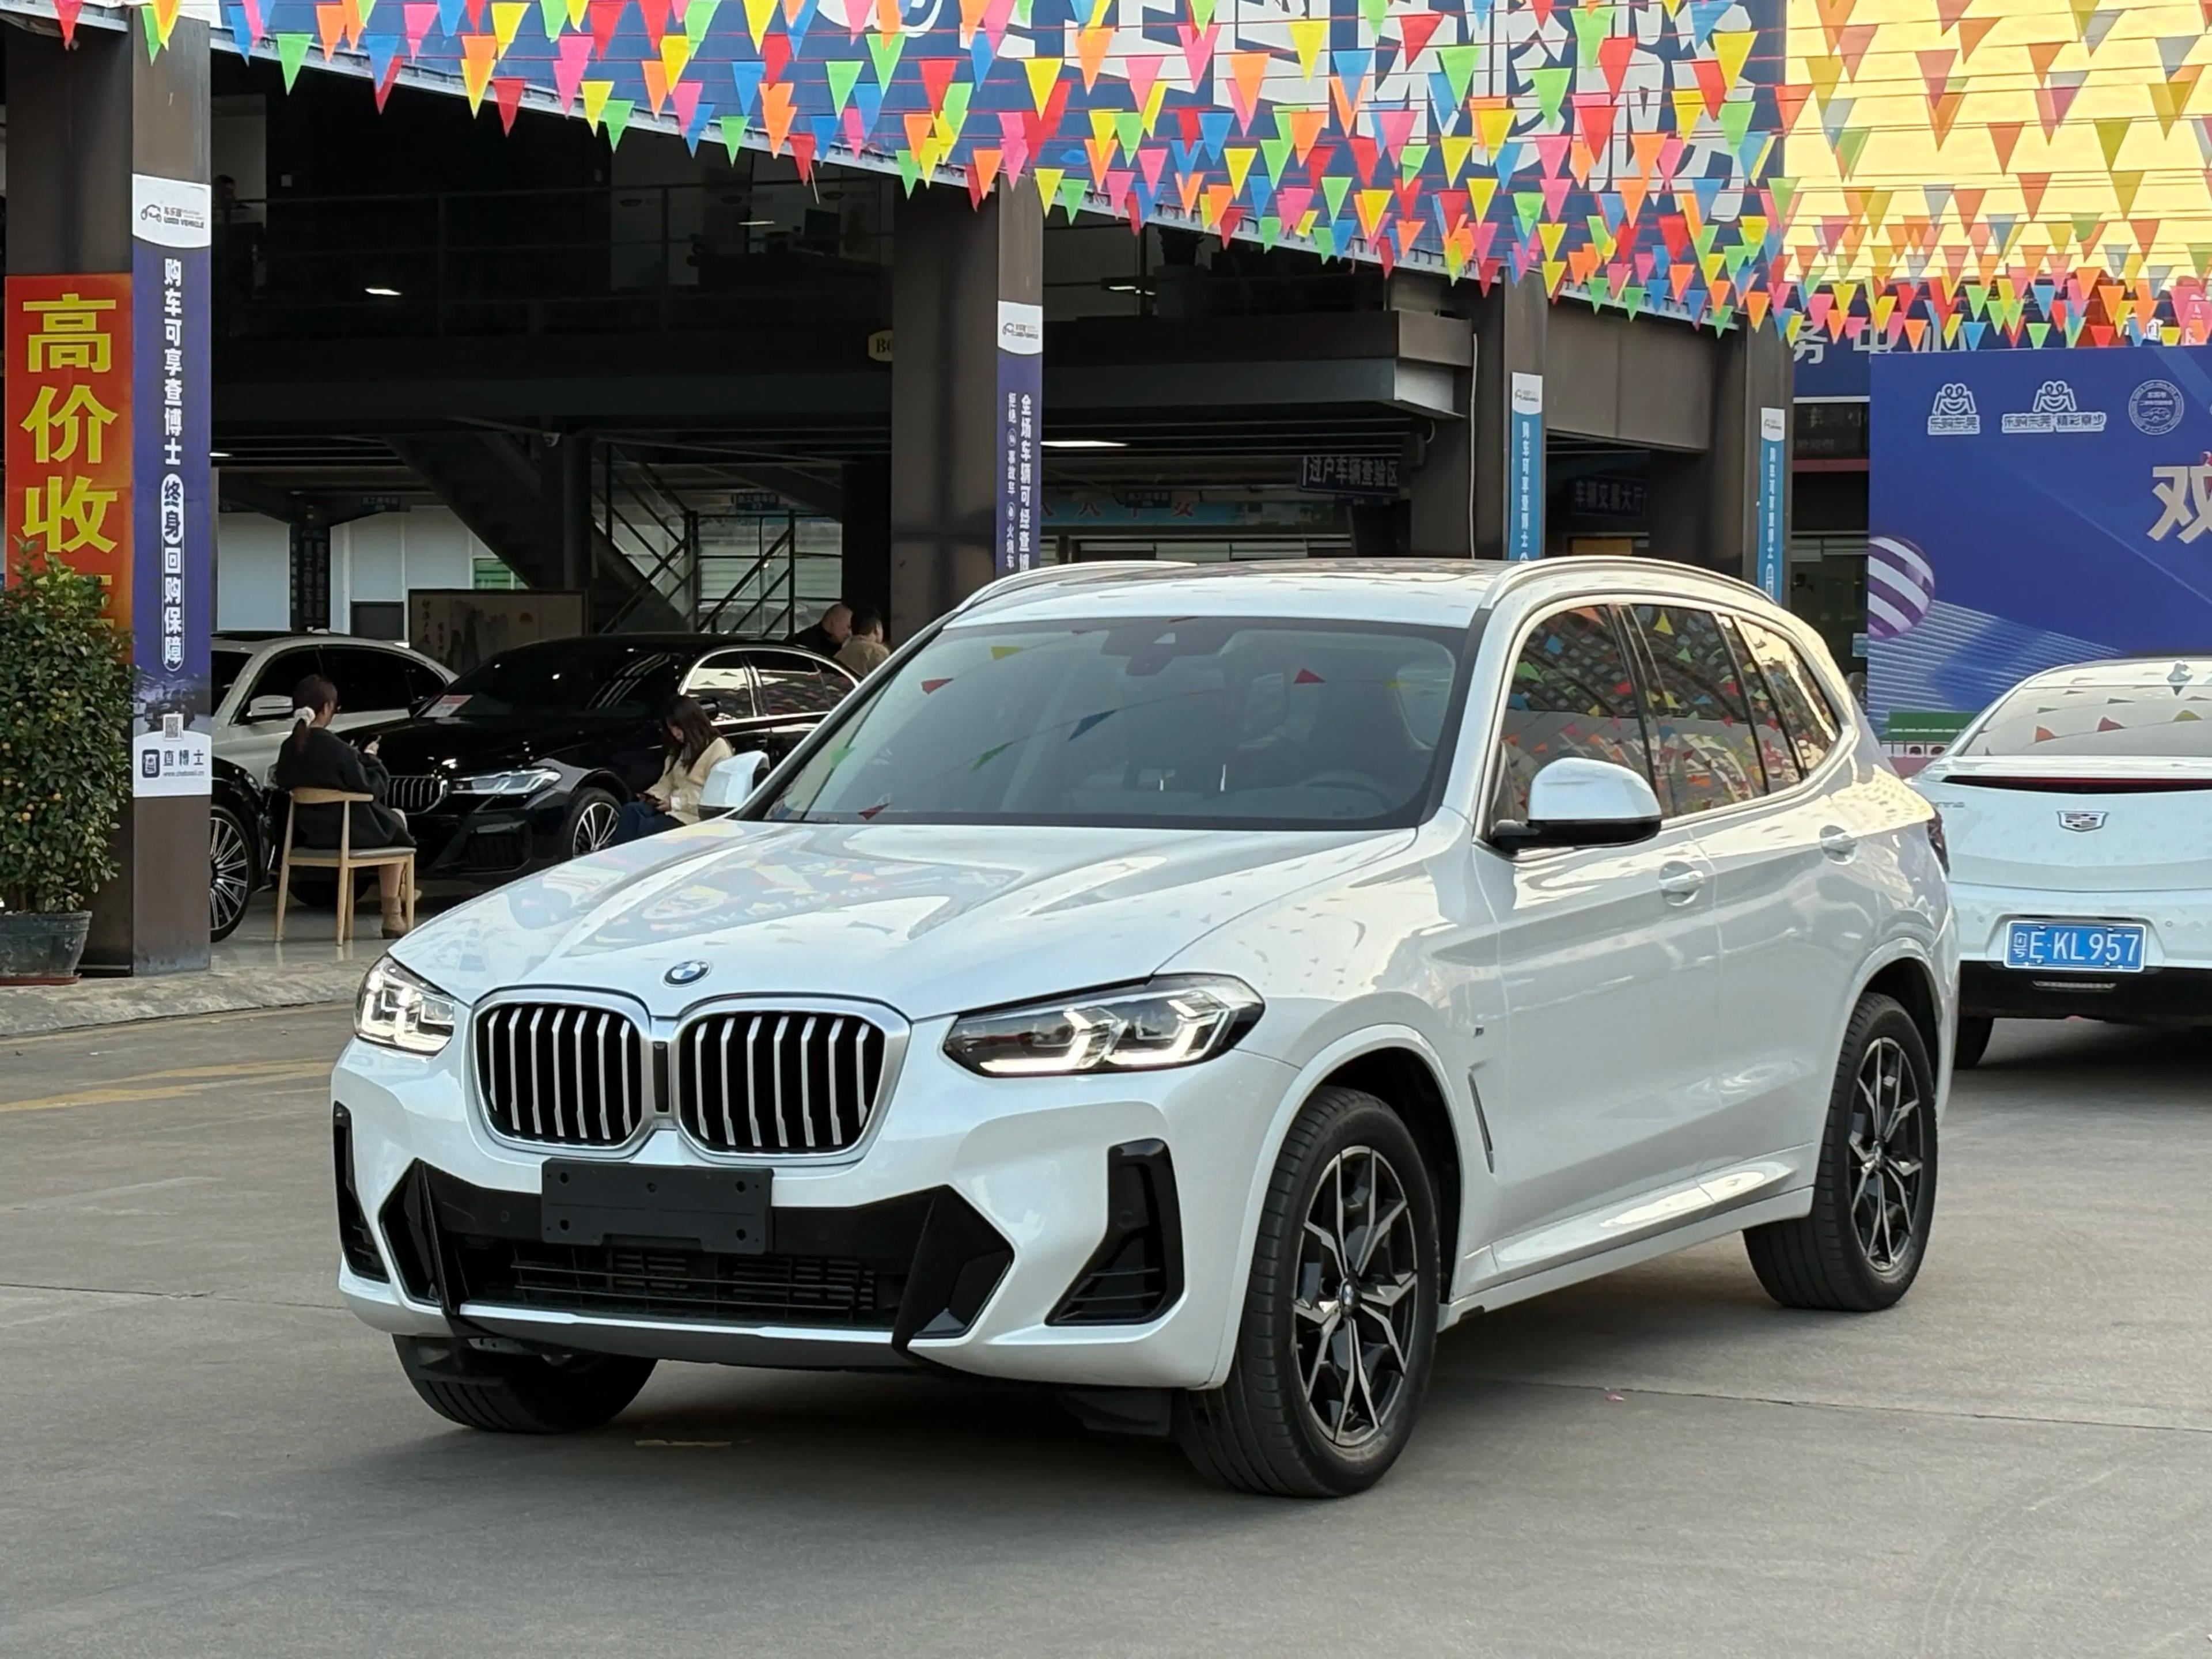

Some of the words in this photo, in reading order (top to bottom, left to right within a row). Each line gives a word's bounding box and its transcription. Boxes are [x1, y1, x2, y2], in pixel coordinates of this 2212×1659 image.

[21, 293, 119, 629] 高价收
[164, 258, 183, 465] 购车可享查博士
